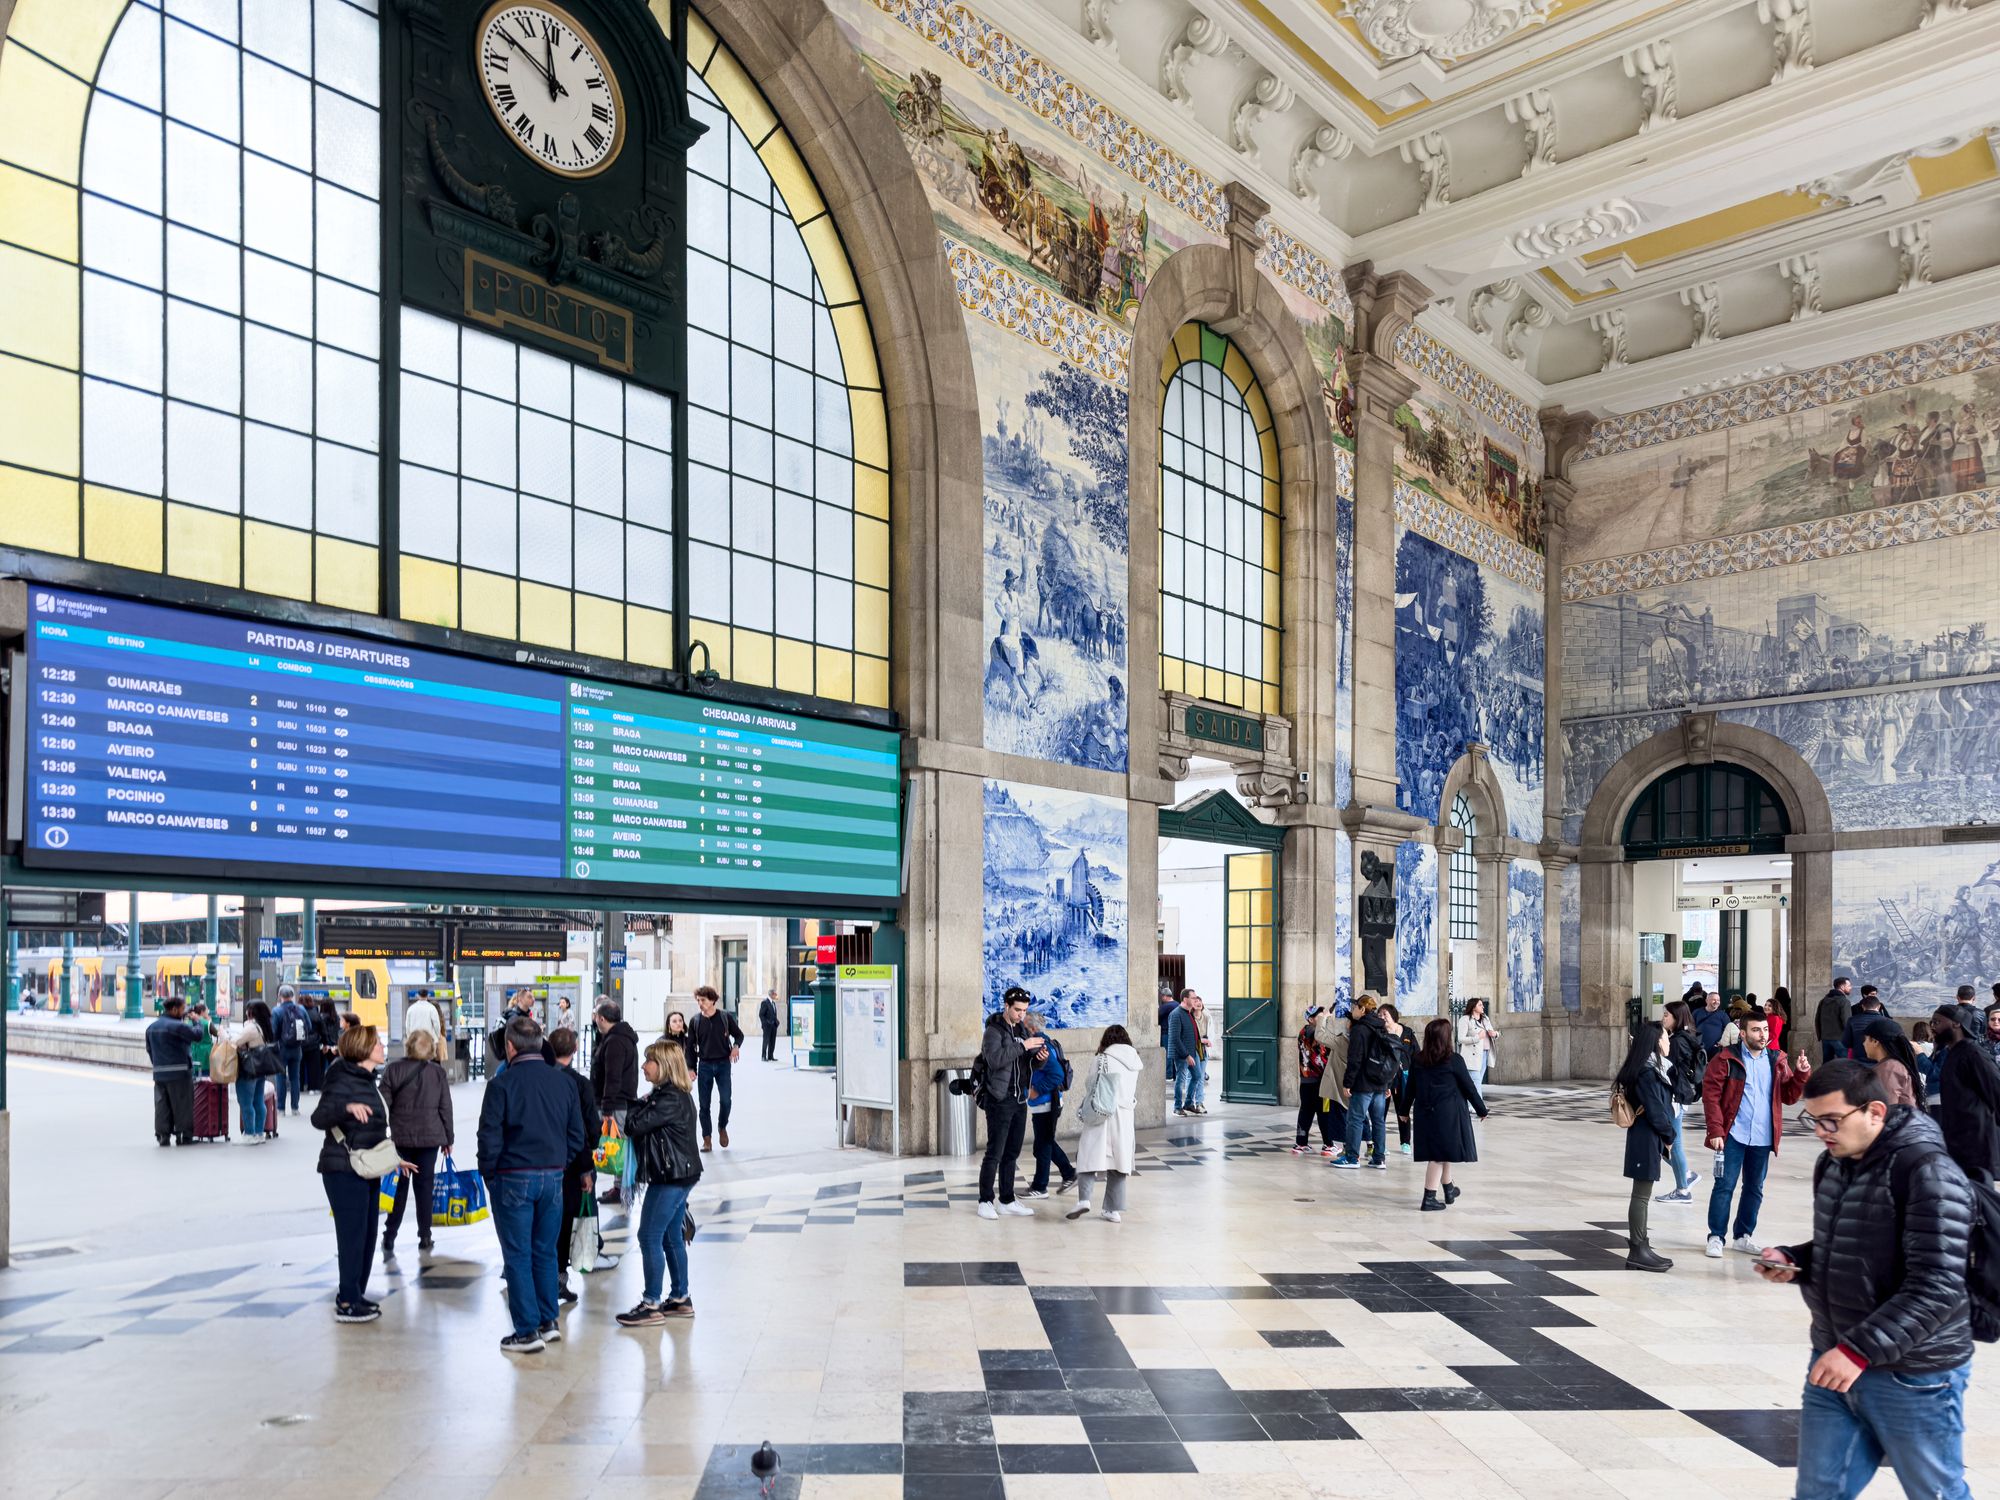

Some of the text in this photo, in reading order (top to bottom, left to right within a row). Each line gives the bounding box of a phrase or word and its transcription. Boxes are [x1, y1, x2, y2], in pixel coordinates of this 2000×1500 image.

[495, 271, 607, 343] PORTO
[57, 598, 108, 614] Infraestruturas
[42, 626, 414, 689] HORA DESTINO LN COMBOIO OBSERVAÇÕES
[247, 631, 315, 654] PARTIDAS
[325, 644, 411, 669] DEPARTURES
[42, 667, 76, 682] 12:25
[107, 676, 182, 696] GUIMARÃES
[250, 695, 258, 706] 2
[42, 690, 76, 705] 12:30
[107, 698, 155, 714] MARCO
[157, 704, 229, 723] CANAVESES
[250, 716, 258, 727] 3
[573, 707, 590, 716] HORA
[702, 707, 751, 724] CHEGADAS
[757, 717, 797, 731] ARRIVALS
[42, 713, 76, 728] 12:40
[107, 721, 154, 736] BRAGA
[573, 722, 593, 732] 11:50
[612, 727, 641, 739] BRAGA
[700, 740, 705, 749] 2
[1195, 712, 1253, 744] SAIDA
[42, 736, 76, 750] 12:50
[107, 744, 155, 758] AVEIRO
[573, 739, 594, 750] 12:30
[612, 744, 641, 756] MARCO
[643, 748, 687, 762] CANAVESES
[42, 760, 76, 774] 13:05
[107, 765, 166, 783] VALENÇA
[250, 779, 258, 790] 1
[277, 783, 285, 792] IR
[573, 757, 594, 767] 12:40
[612, 761, 641, 773] RÉGUA
[700, 772, 705, 782] 2
[42, 783, 76, 797] 13:20
[107, 788, 165, 803] POCINHO
[277, 803, 285, 812] IR
[573, 775, 594, 785] 12:45
[612, 779, 641, 790] BRAGA
[700, 789, 705, 798] 4
[573, 793, 594, 803] 13:05
[612, 797, 658, 810] GUIMARÃES
[42, 806, 76, 820] 13:30
[107, 808, 155, 823] MARCO
[157, 813, 229, 828] CANAVESES
[573, 811, 594, 820] 13:30
[612, 814, 641, 825] MARCO
[643, 817, 687, 829] CANAVESES
[700, 822, 705, 831] 1
[573, 828, 594, 838] 13:40
[612, 831, 641, 842] AVEIRO
[700, 838, 705, 848] 2
[573, 846, 594, 856] 13:45
[612, 848, 641, 860] BRAGA
[700, 855, 705, 864] 3
[1712, 898, 1720, 908] P
[260, 944, 278, 954] PRT1
